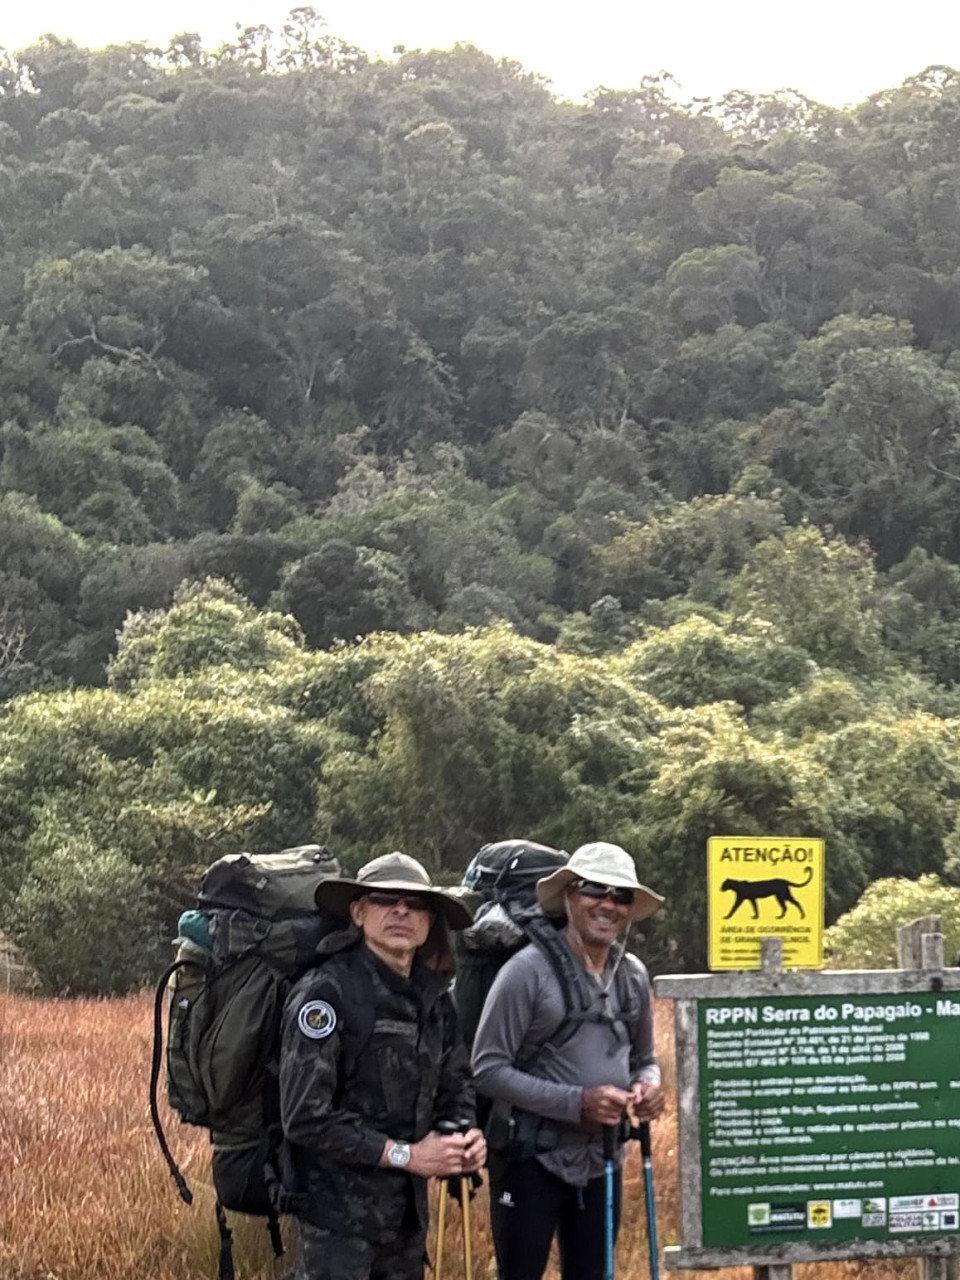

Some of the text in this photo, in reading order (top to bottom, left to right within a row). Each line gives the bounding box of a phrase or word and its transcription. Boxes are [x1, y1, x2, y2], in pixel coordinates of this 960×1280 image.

[720, 844, 814, 865] ATENÇÃO!
[706, 1007, 758, 1024] RPPN
[762, 1006, 810, 1022] Serra
[814, 1005, 838, 1020] do
[842, 1002, 922, 1022] Papagaio
